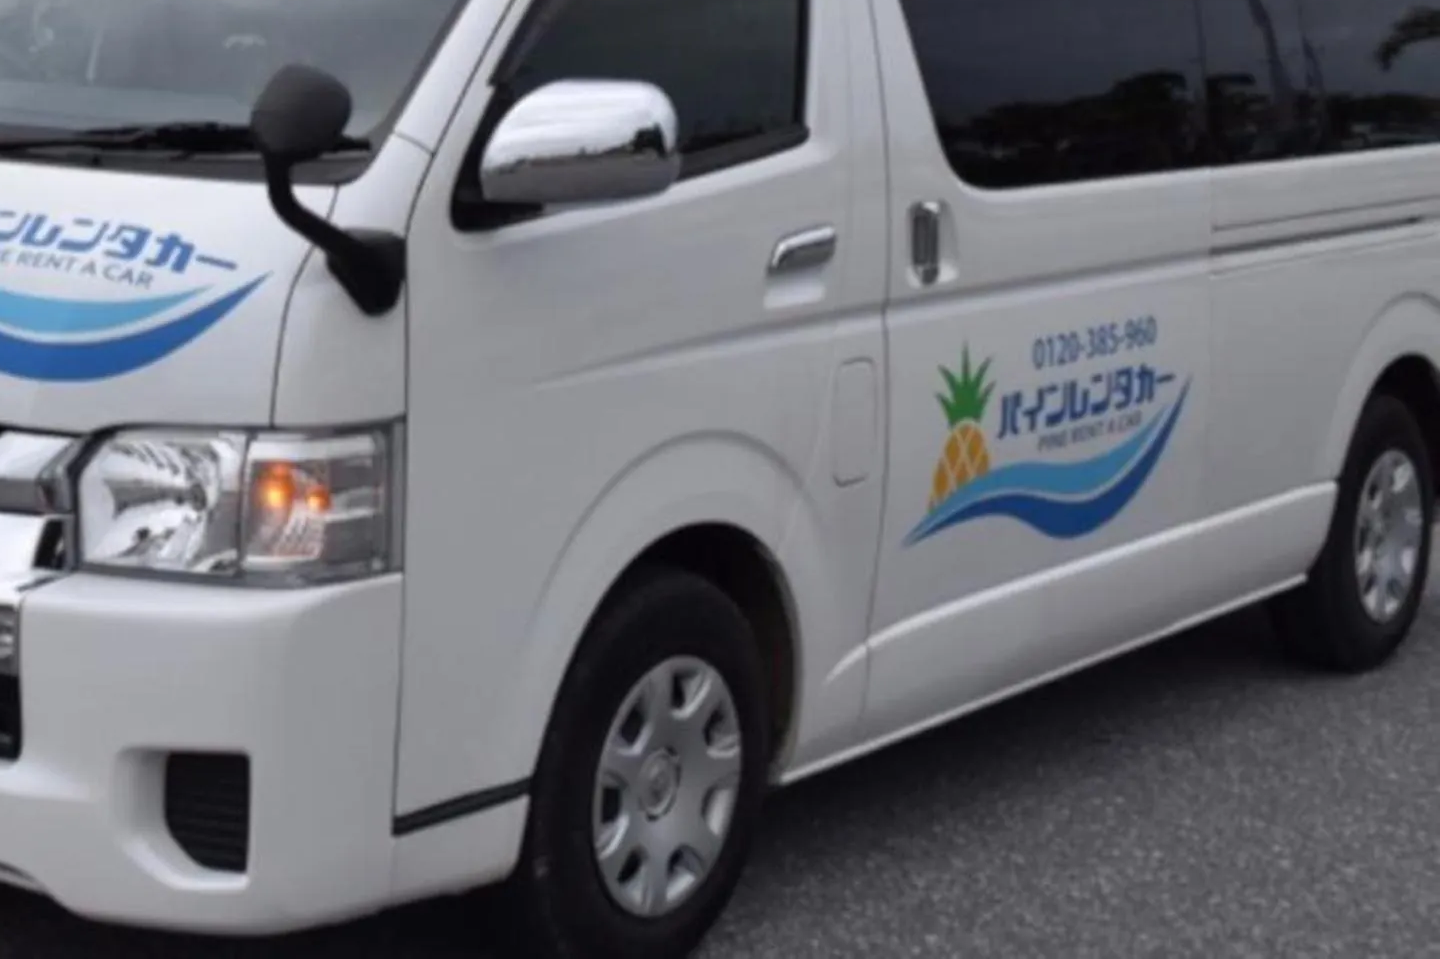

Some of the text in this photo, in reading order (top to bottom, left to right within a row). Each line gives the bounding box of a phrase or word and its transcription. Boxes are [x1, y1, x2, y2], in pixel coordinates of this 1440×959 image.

[16, 252, 77, 274] RENT
[79, 259, 98, 276] A
[101, 264, 156, 290] CAR
[1032, 314, 1158, 371] 0120-385-960
[997, 362, 1177, 440] パインレンタカー
